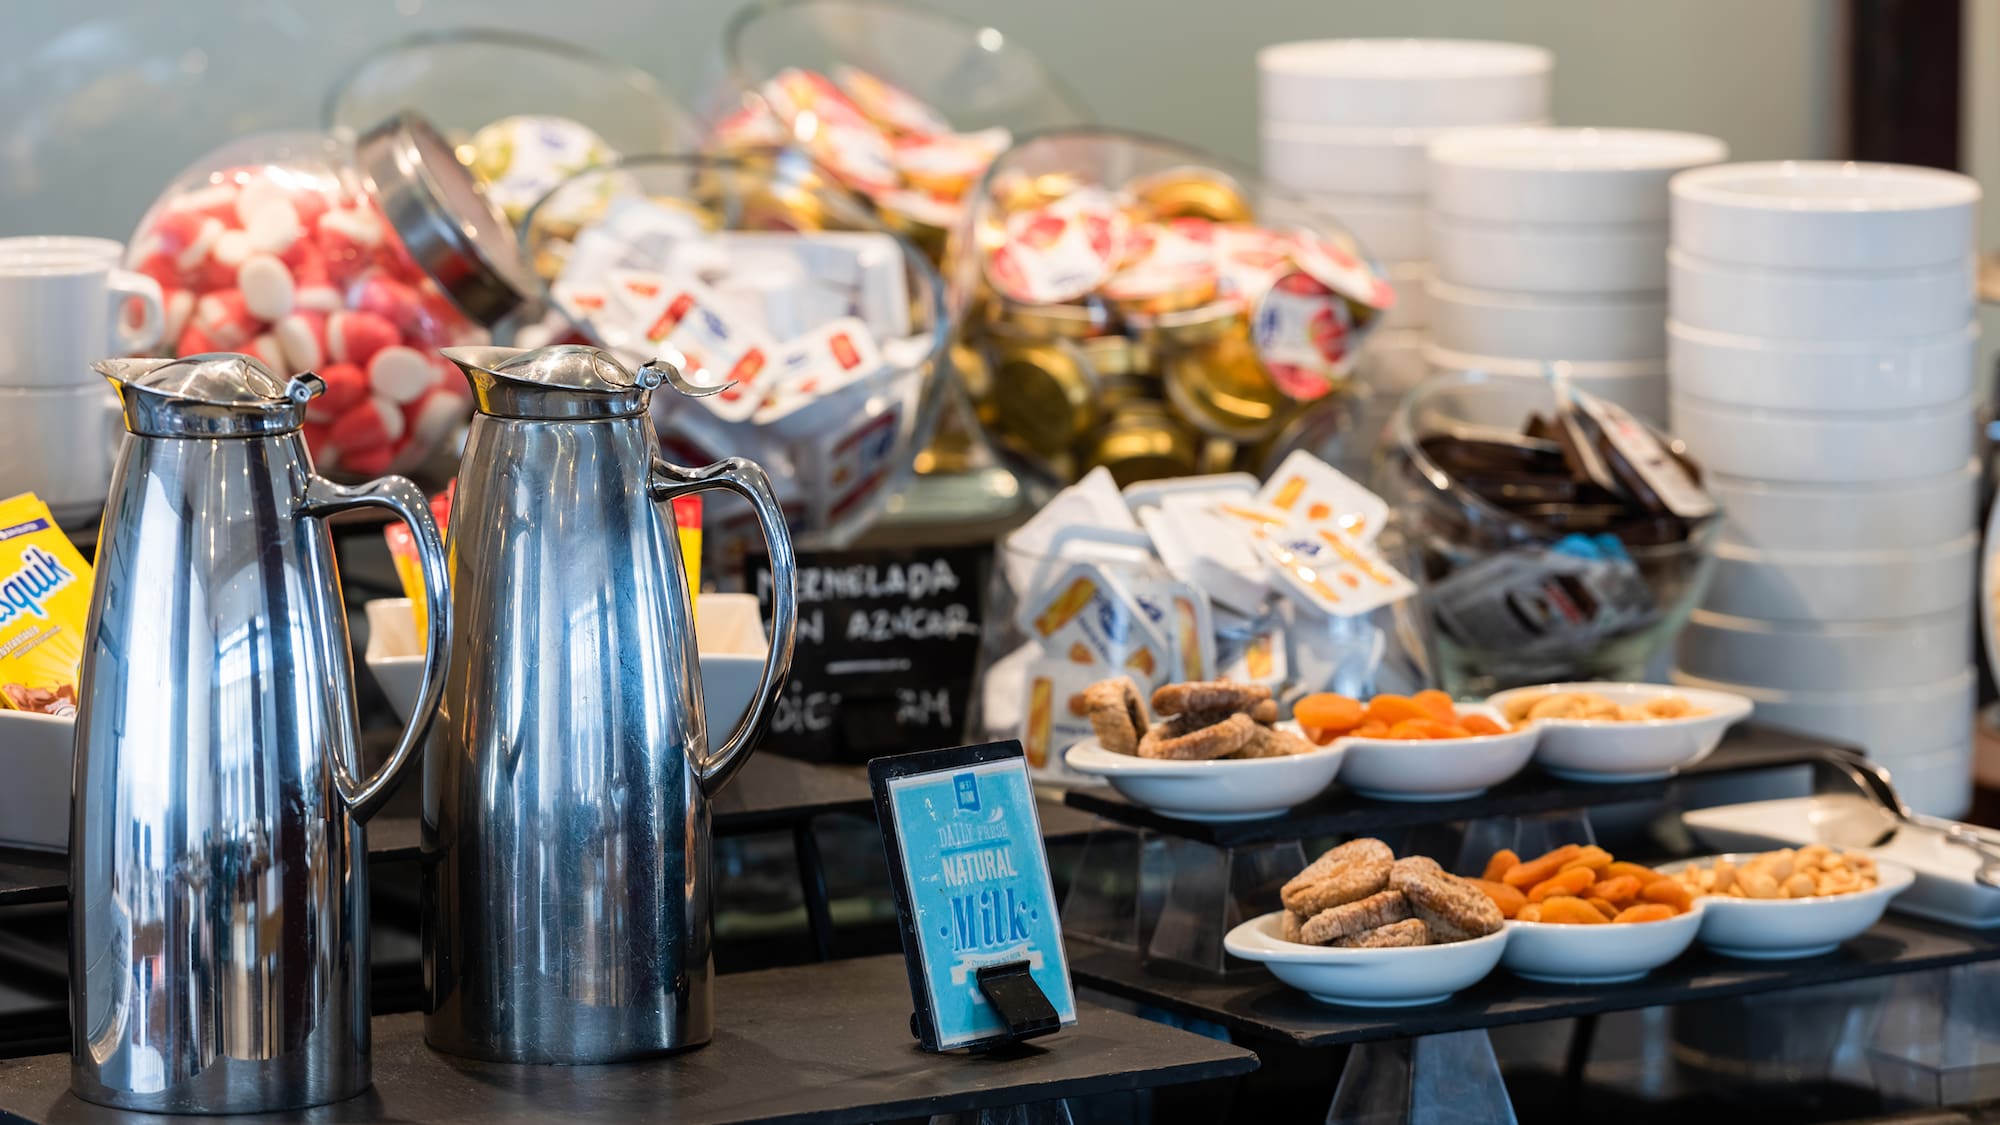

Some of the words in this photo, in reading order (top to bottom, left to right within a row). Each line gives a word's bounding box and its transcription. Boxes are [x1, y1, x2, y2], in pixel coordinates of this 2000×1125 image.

[938, 822, 973, 848] DAILY
[976, 820, 1009, 841] FRESH
[942, 848, 1018, 888] NATURAL
[951, 887, 1030, 951] Milk
